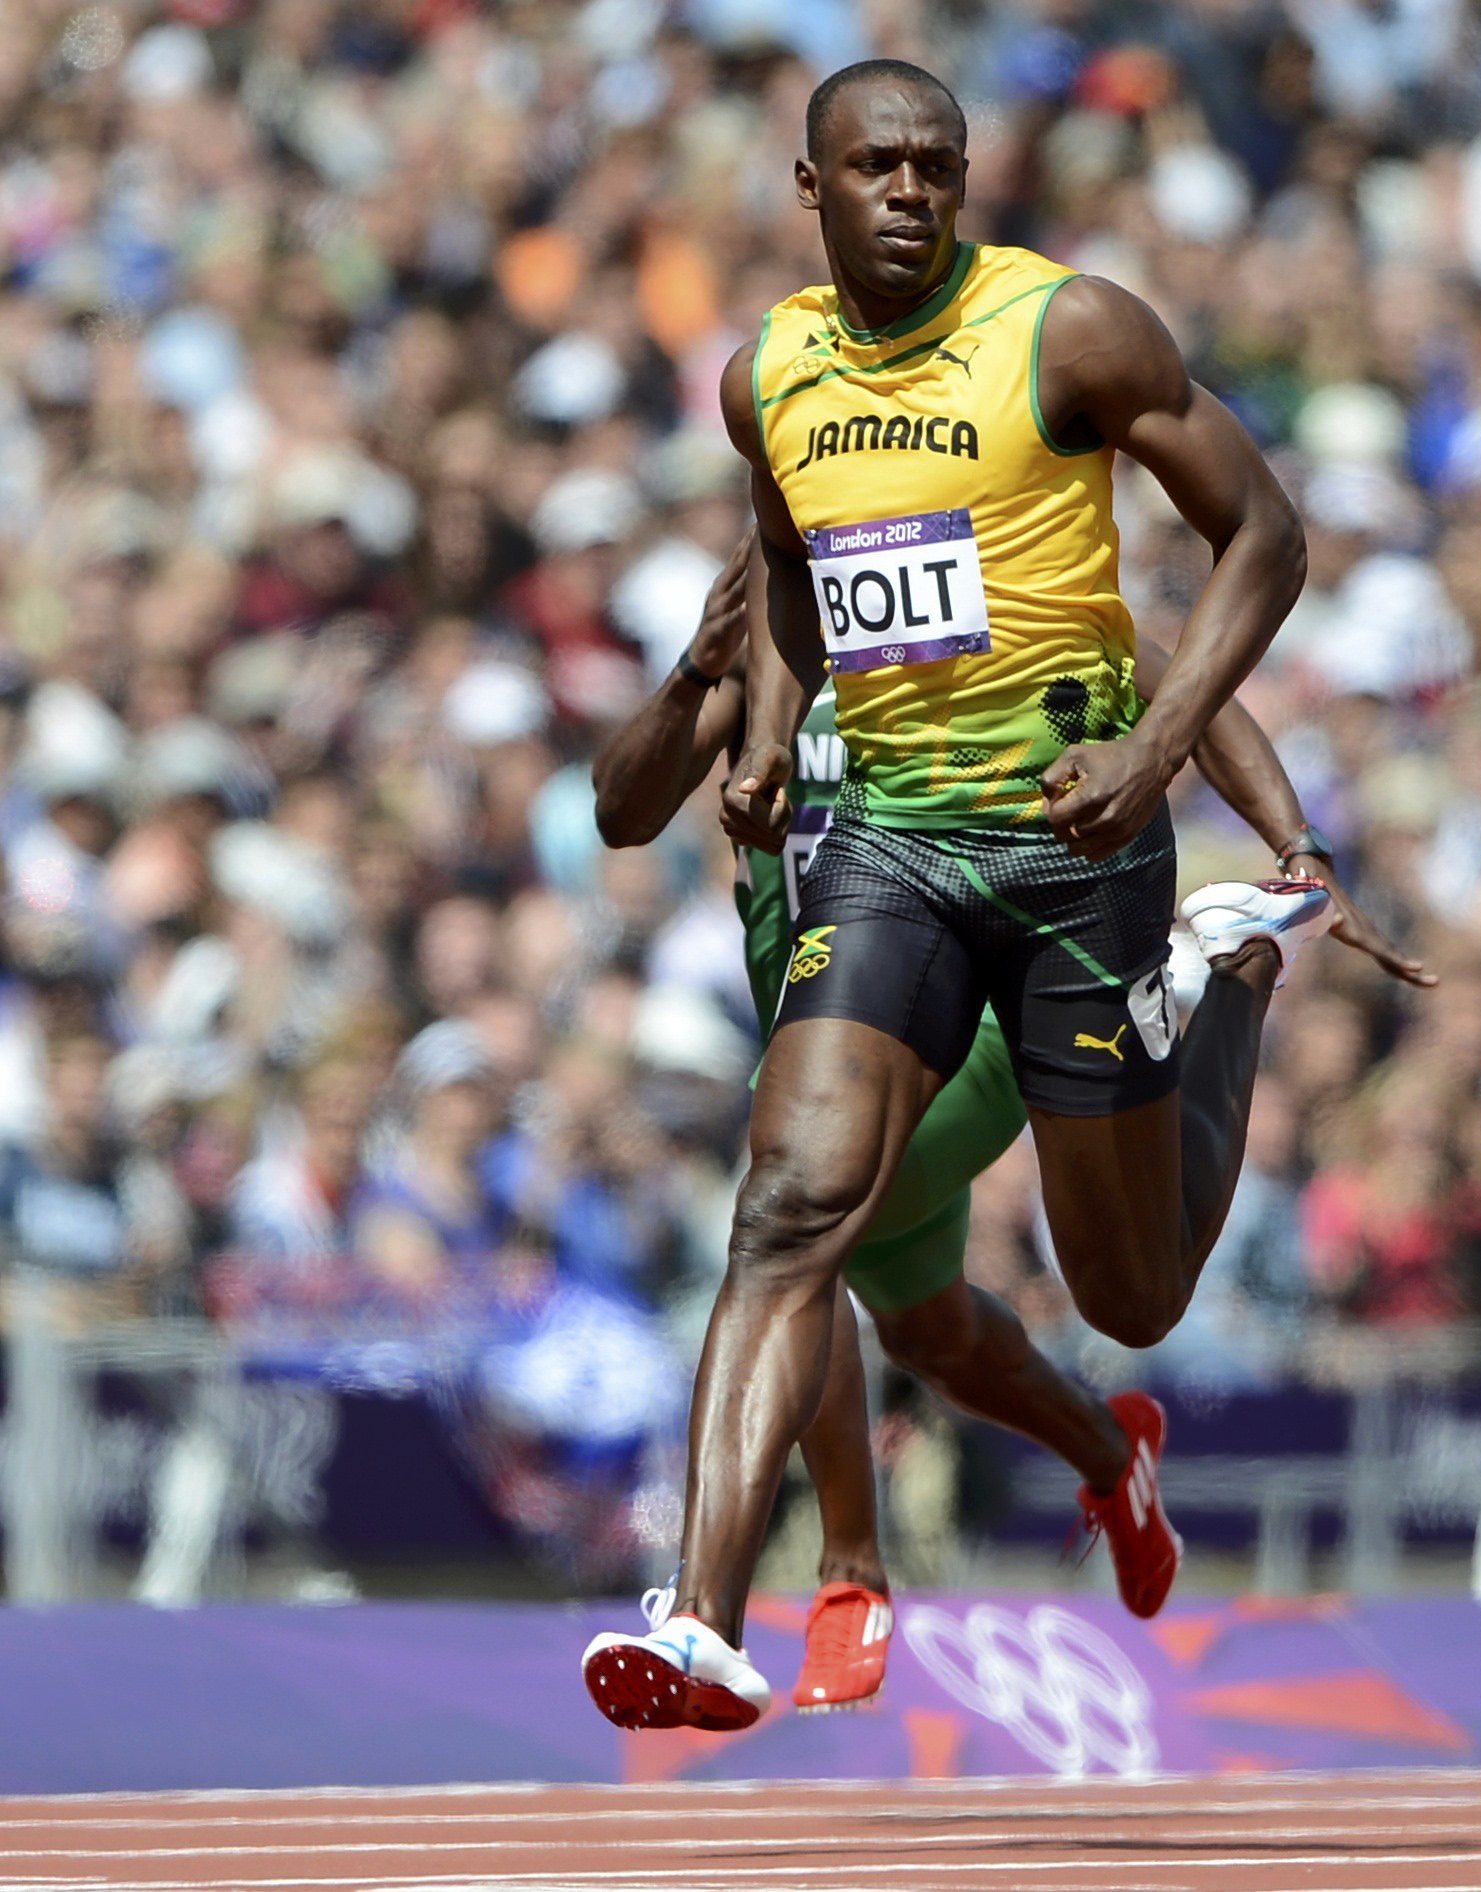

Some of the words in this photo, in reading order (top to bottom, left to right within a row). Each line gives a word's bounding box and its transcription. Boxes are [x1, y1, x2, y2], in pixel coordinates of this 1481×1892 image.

[796, 414, 979, 473] JAMAICA
[830, 529, 882, 552] London
[885, 521, 922, 544] 2012
[821, 558, 958, 637] BOLT
